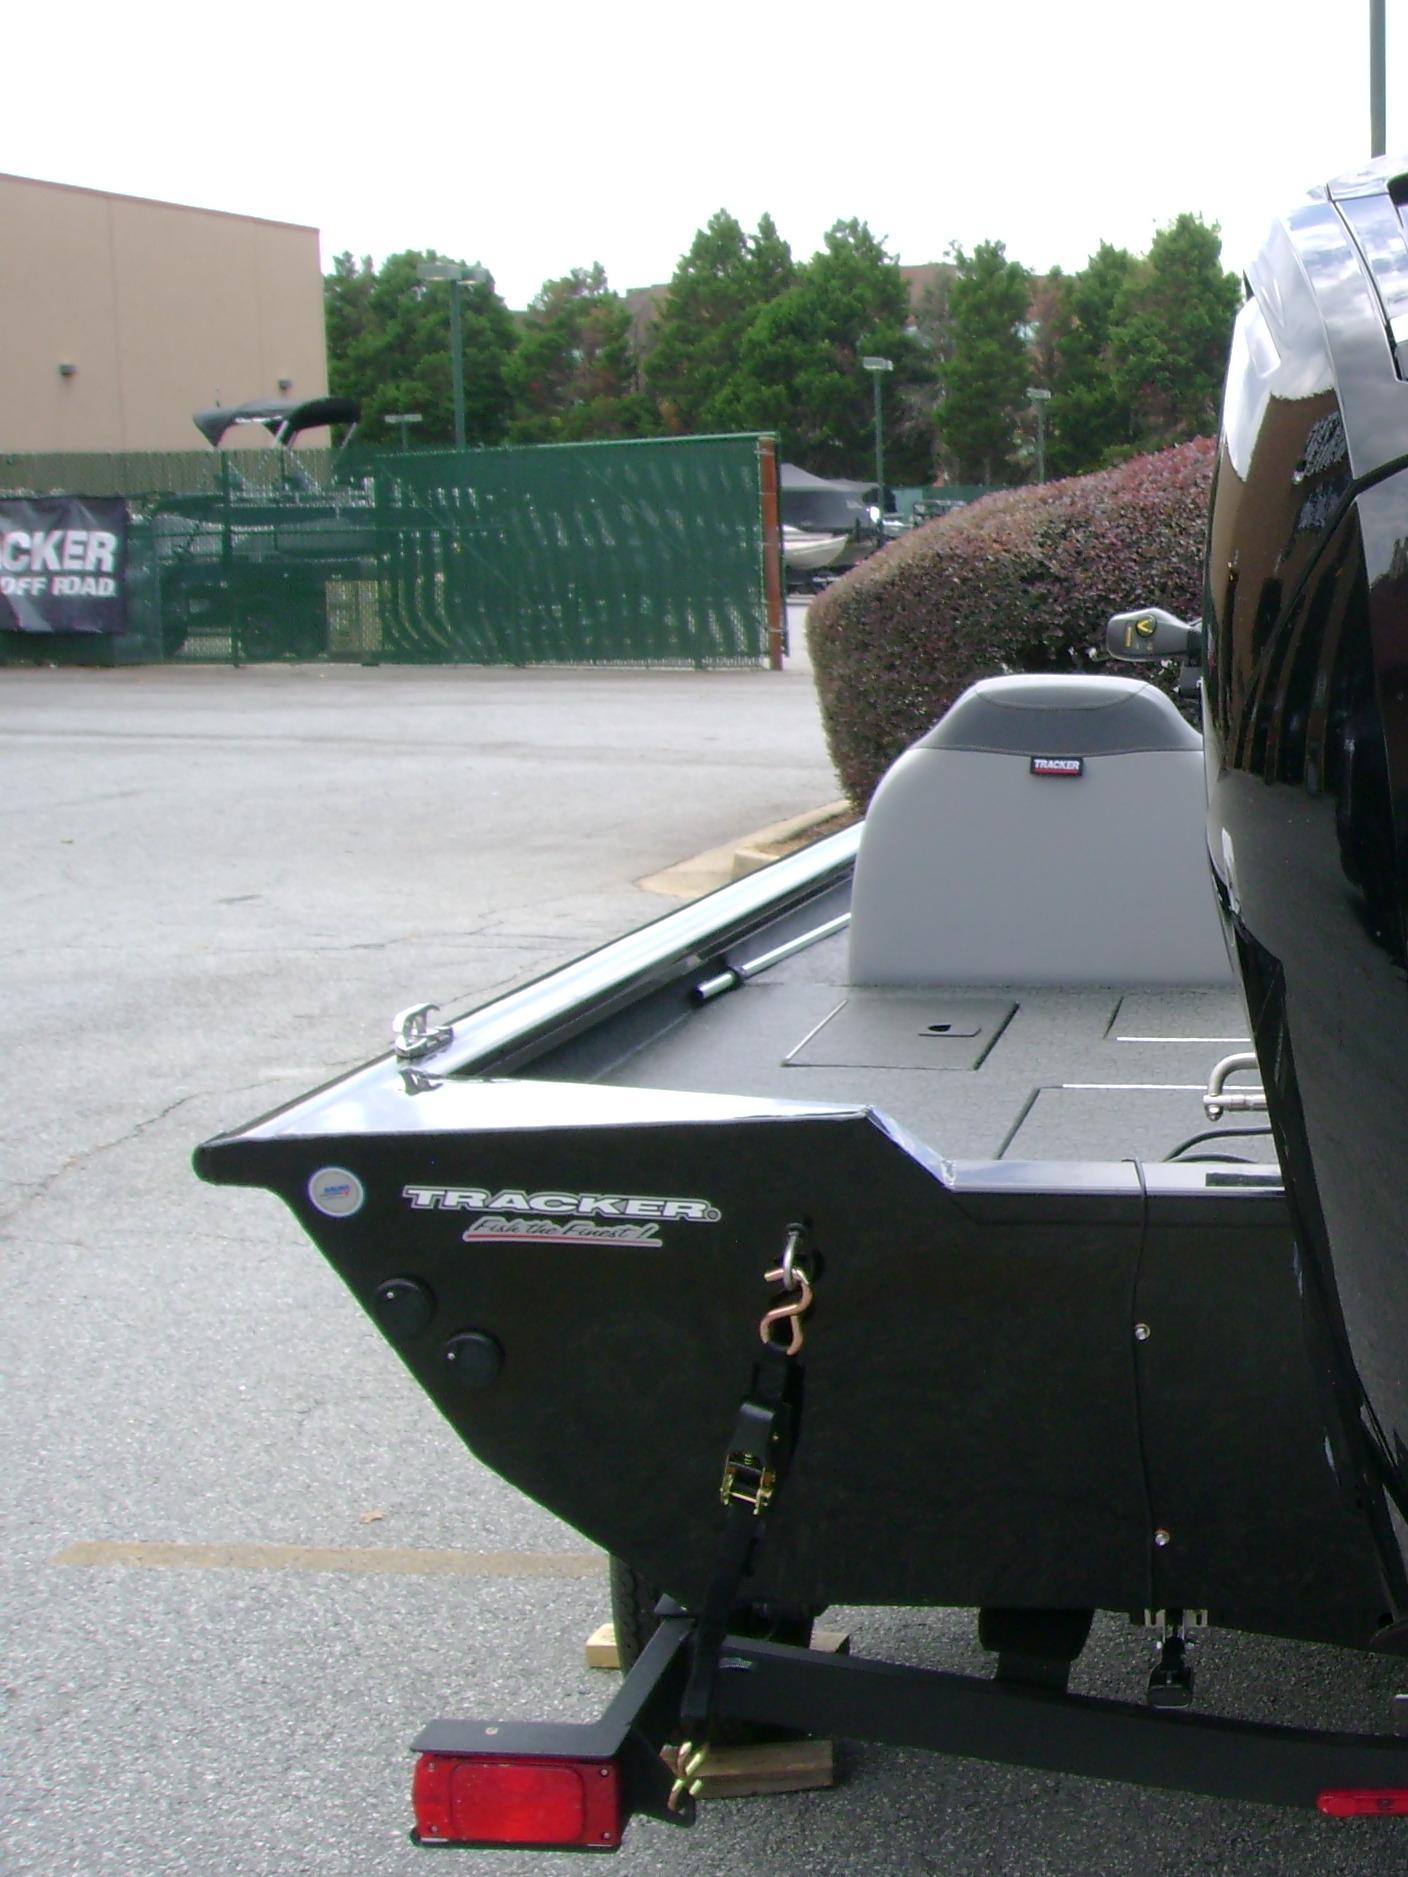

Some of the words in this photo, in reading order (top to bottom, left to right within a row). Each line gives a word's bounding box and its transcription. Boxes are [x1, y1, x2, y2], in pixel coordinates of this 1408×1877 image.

[0, 530, 117, 573] CKER
[0, 576, 47, 596] OFF
[52, 575, 116, 597] ROAD
[1034, 759, 1080, 770] TRACKER
[405, 1187, 709, 1219] TRACKER
[473, 1217, 519, 1233] Fish
[526, 1220, 558, 1235] the
